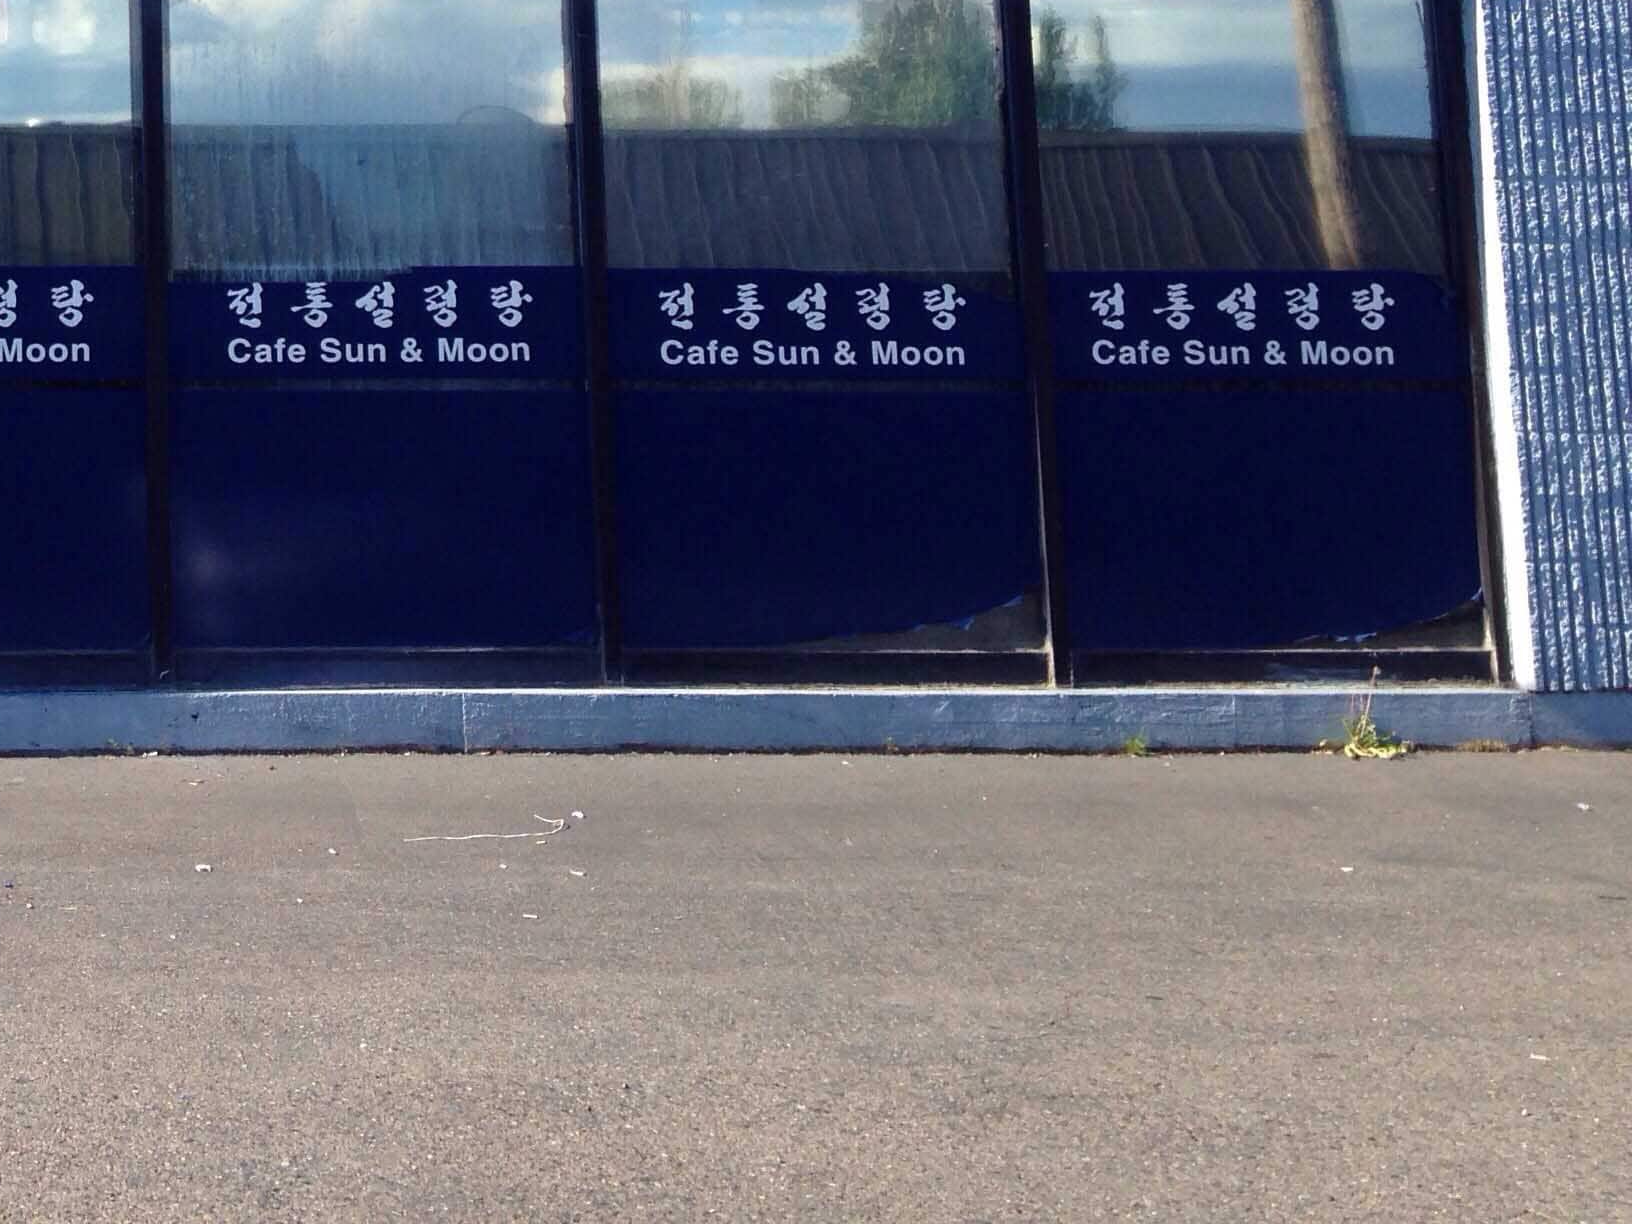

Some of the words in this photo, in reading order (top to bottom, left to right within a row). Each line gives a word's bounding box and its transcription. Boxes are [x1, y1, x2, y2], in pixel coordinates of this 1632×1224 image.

[227, 338, 306, 363] Cafe
[320, 338, 386, 363] Sun
[400, 338, 424, 362] &
[437, 338, 530, 362] Moon
[660, 340, 739, 365] Cafe
[752, 340, 820, 365] Sun
[834, 341, 857, 365] &
[871, 341, 965, 365] Moon
[1092, 340, 1170, 365] Cafe
[1183, 340, 1250, 365] Sun
[1263, 341, 1287, 365] &
[1300, 341, 1394, 365] Moon
